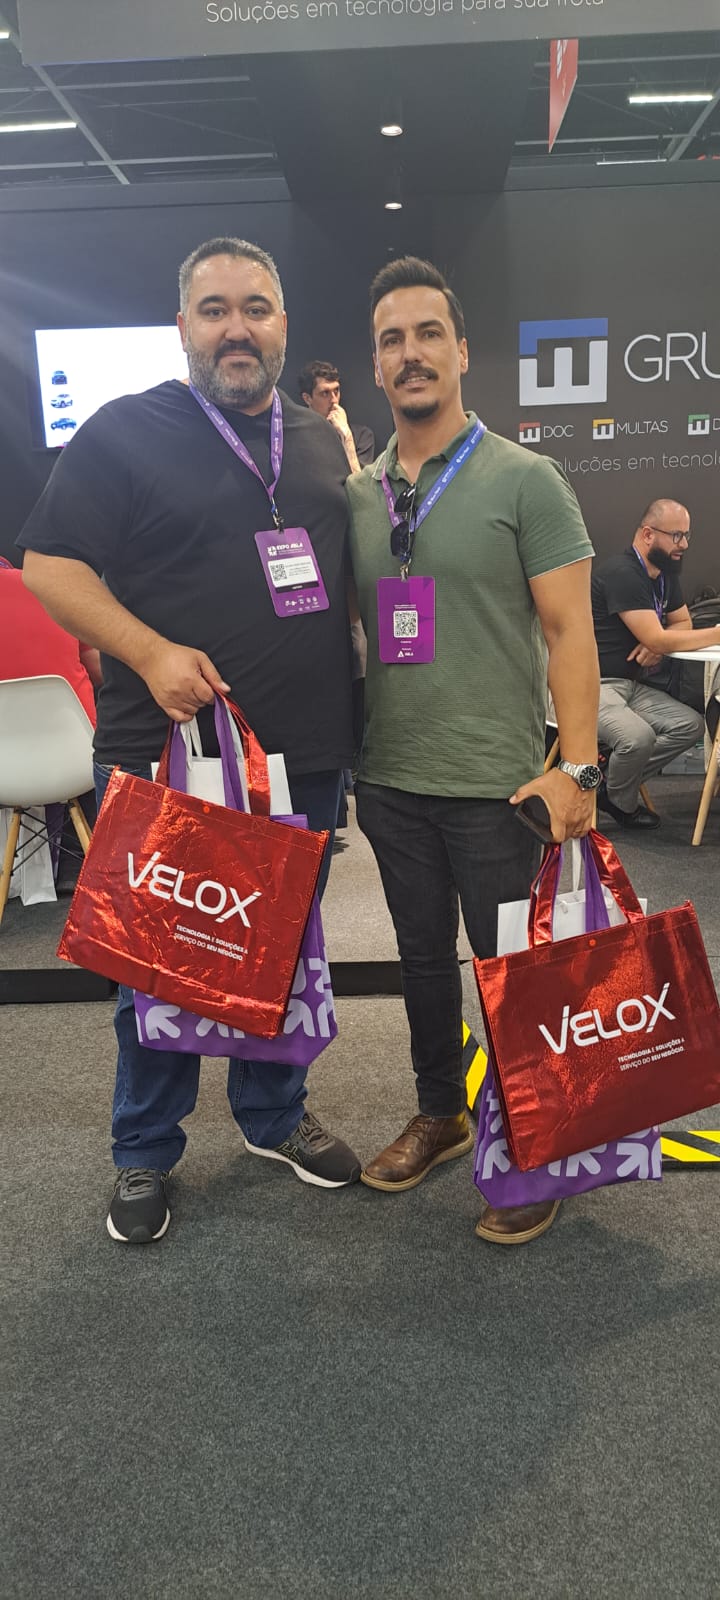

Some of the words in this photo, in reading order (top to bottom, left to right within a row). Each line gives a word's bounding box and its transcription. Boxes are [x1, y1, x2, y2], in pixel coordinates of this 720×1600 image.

[206, 1, 300, 23] Soluções
[306, 2, 338, 18] em
[346, 0, 453, 16] tecnologia
[461, 0, 506, 14] para
[543, 424, 575, 438] DOC
[616, 420, 668, 435] MULTAS
[627, 456, 655, 470] em
[663, 450, 720, 469] tecnol
[128, 851, 262, 928] VELOX
[197, 940, 206, 948] DO
[538, 982, 676, 1055] VELOX
